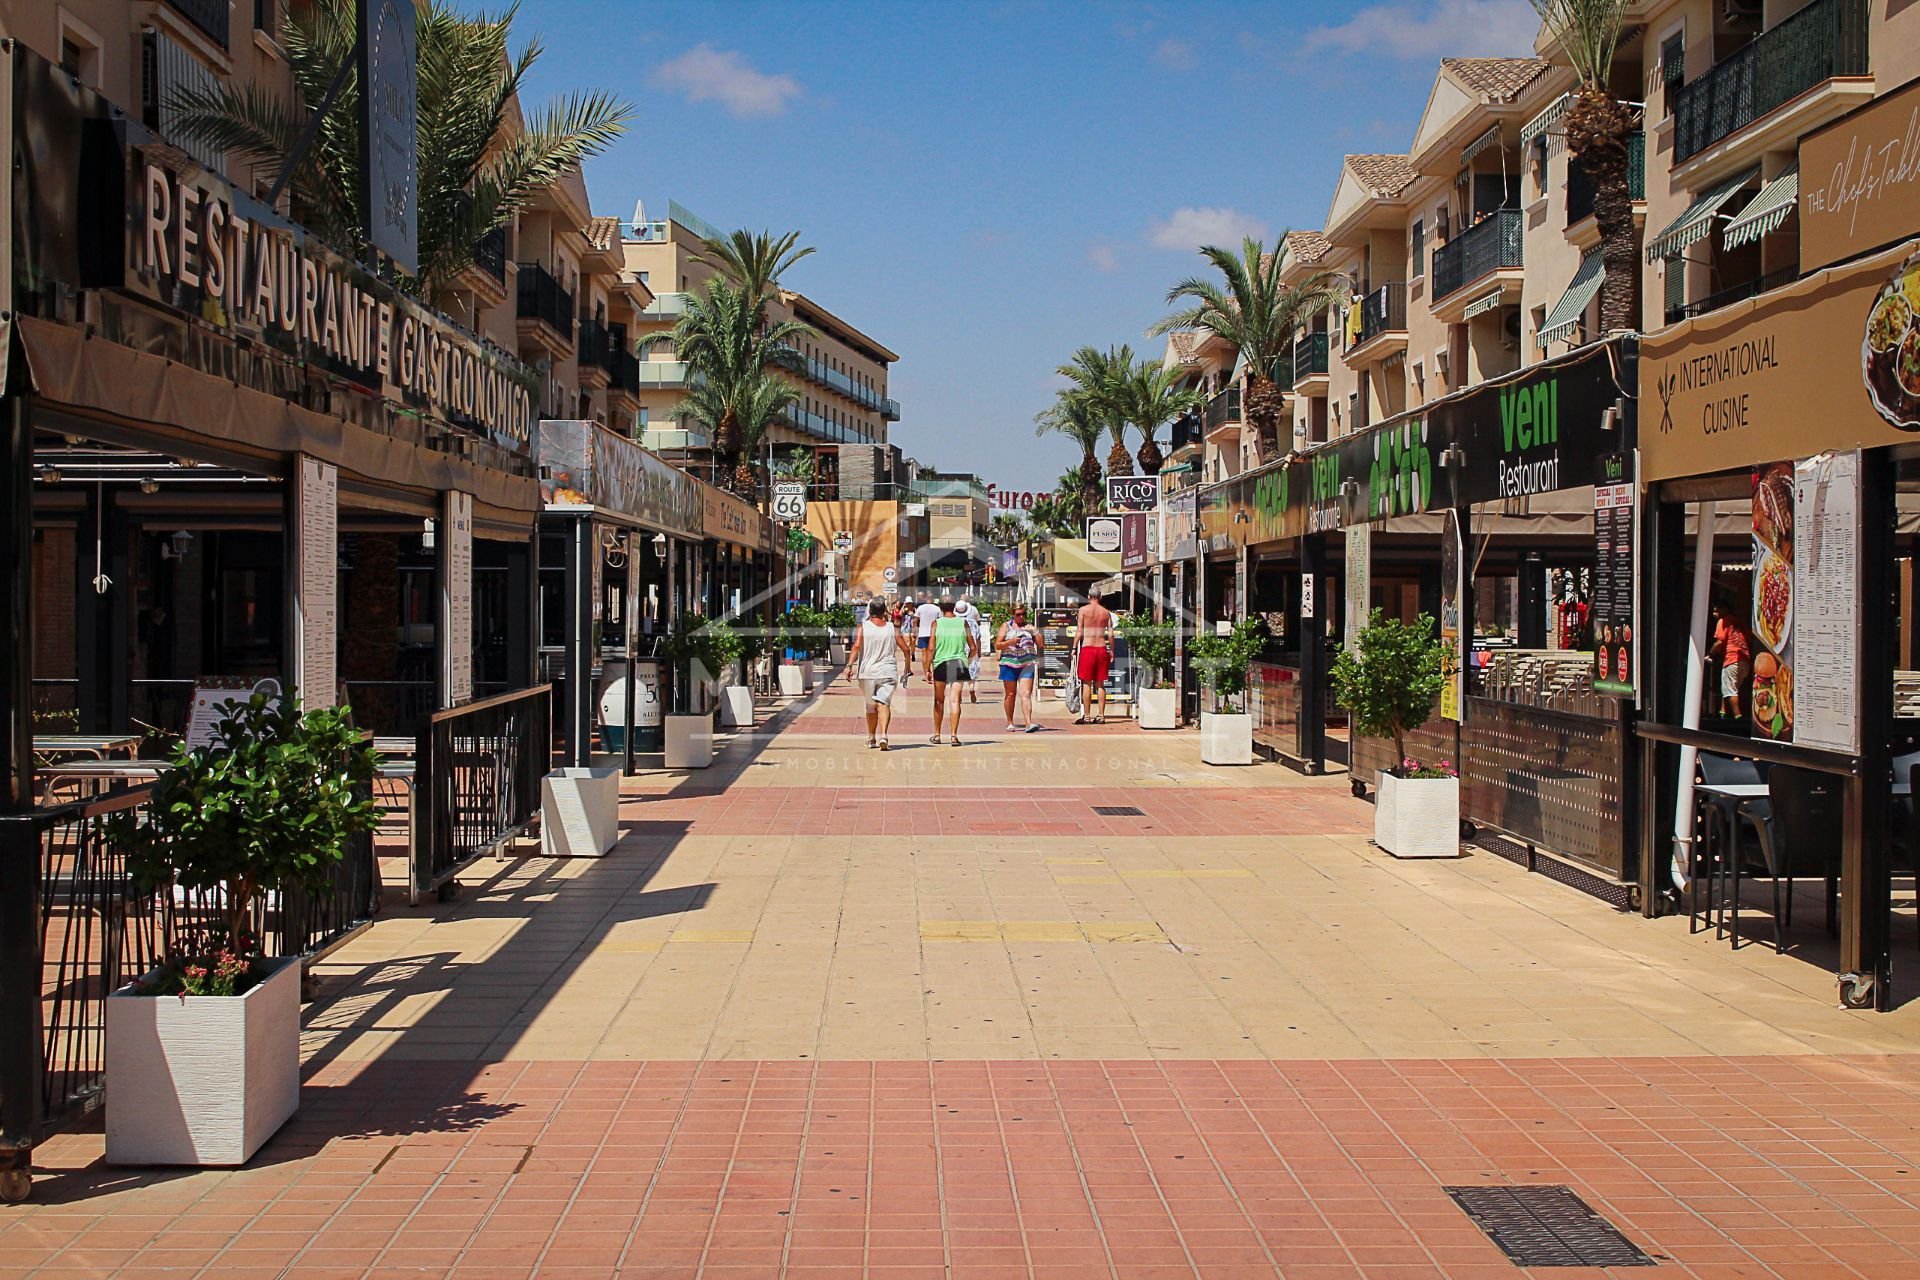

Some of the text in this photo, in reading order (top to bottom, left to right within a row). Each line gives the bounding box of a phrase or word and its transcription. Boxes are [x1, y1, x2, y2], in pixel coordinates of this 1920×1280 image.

[1807, 188, 1825, 215] THE
[1827, 135, 1879, 237] Chef's
[146, 165, 390, 375] RESTAURANTE
[1680, 335, 1778, 392] INTERNATIONAL
[1703, 394, 1749, 435] CUISINE
[1499, 448, 1558, 498] Restaurant
[777, 496, 801, 513] 66
[1309, 500, 1341, 532] Restaurante
